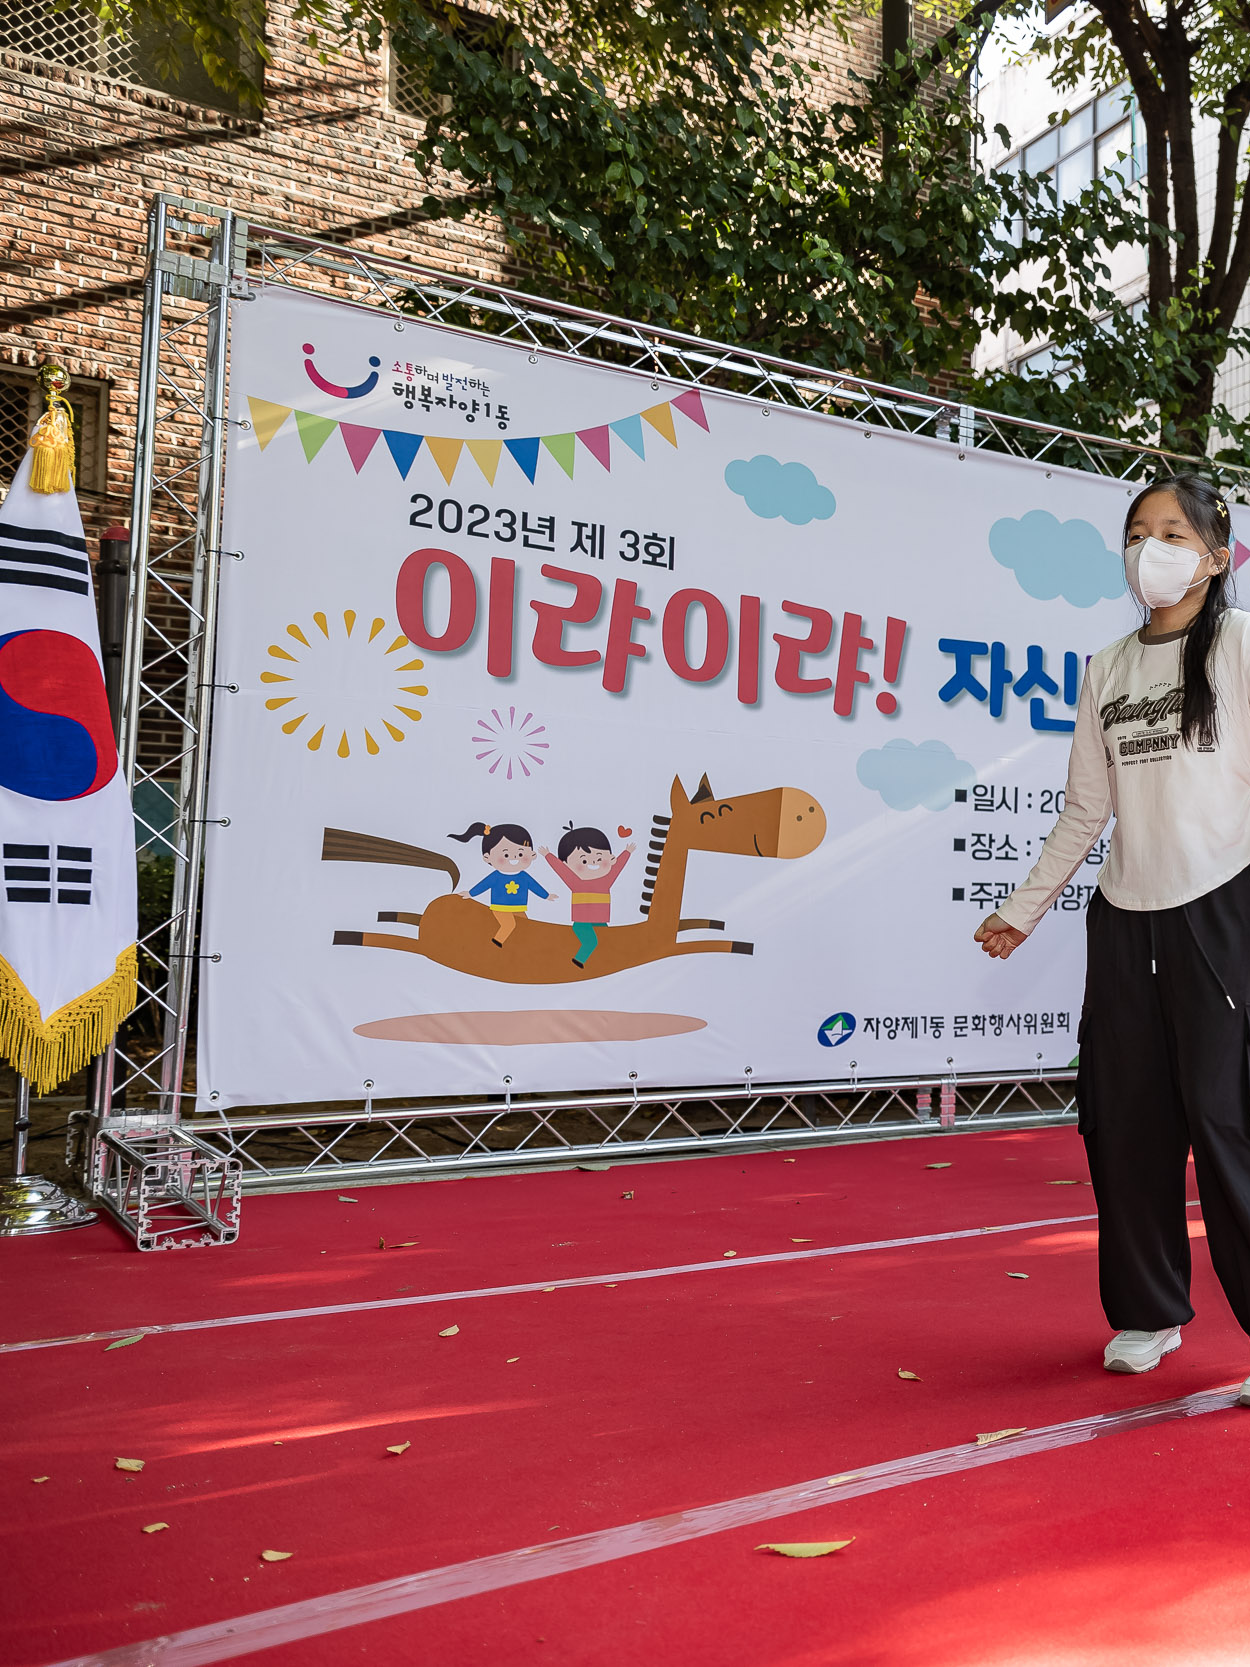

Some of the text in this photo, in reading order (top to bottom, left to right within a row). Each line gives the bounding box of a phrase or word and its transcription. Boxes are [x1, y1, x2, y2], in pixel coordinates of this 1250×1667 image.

[392, 361, 491, 398] 소통하며 발전하는
[392, 382, 510, 431] 행복자양1동
[409, 493, 676, 571] 2023년 제 3회
[395, 548, 907, 718] 이랴이랴!
[938, 638, 1092, 732] 자신
[972, 784, 1018, 814] 일시
[971, 833, 1018, 861] 장소
[863, 1012, 1070, 1040] 자양제1동 문화행사위원회
